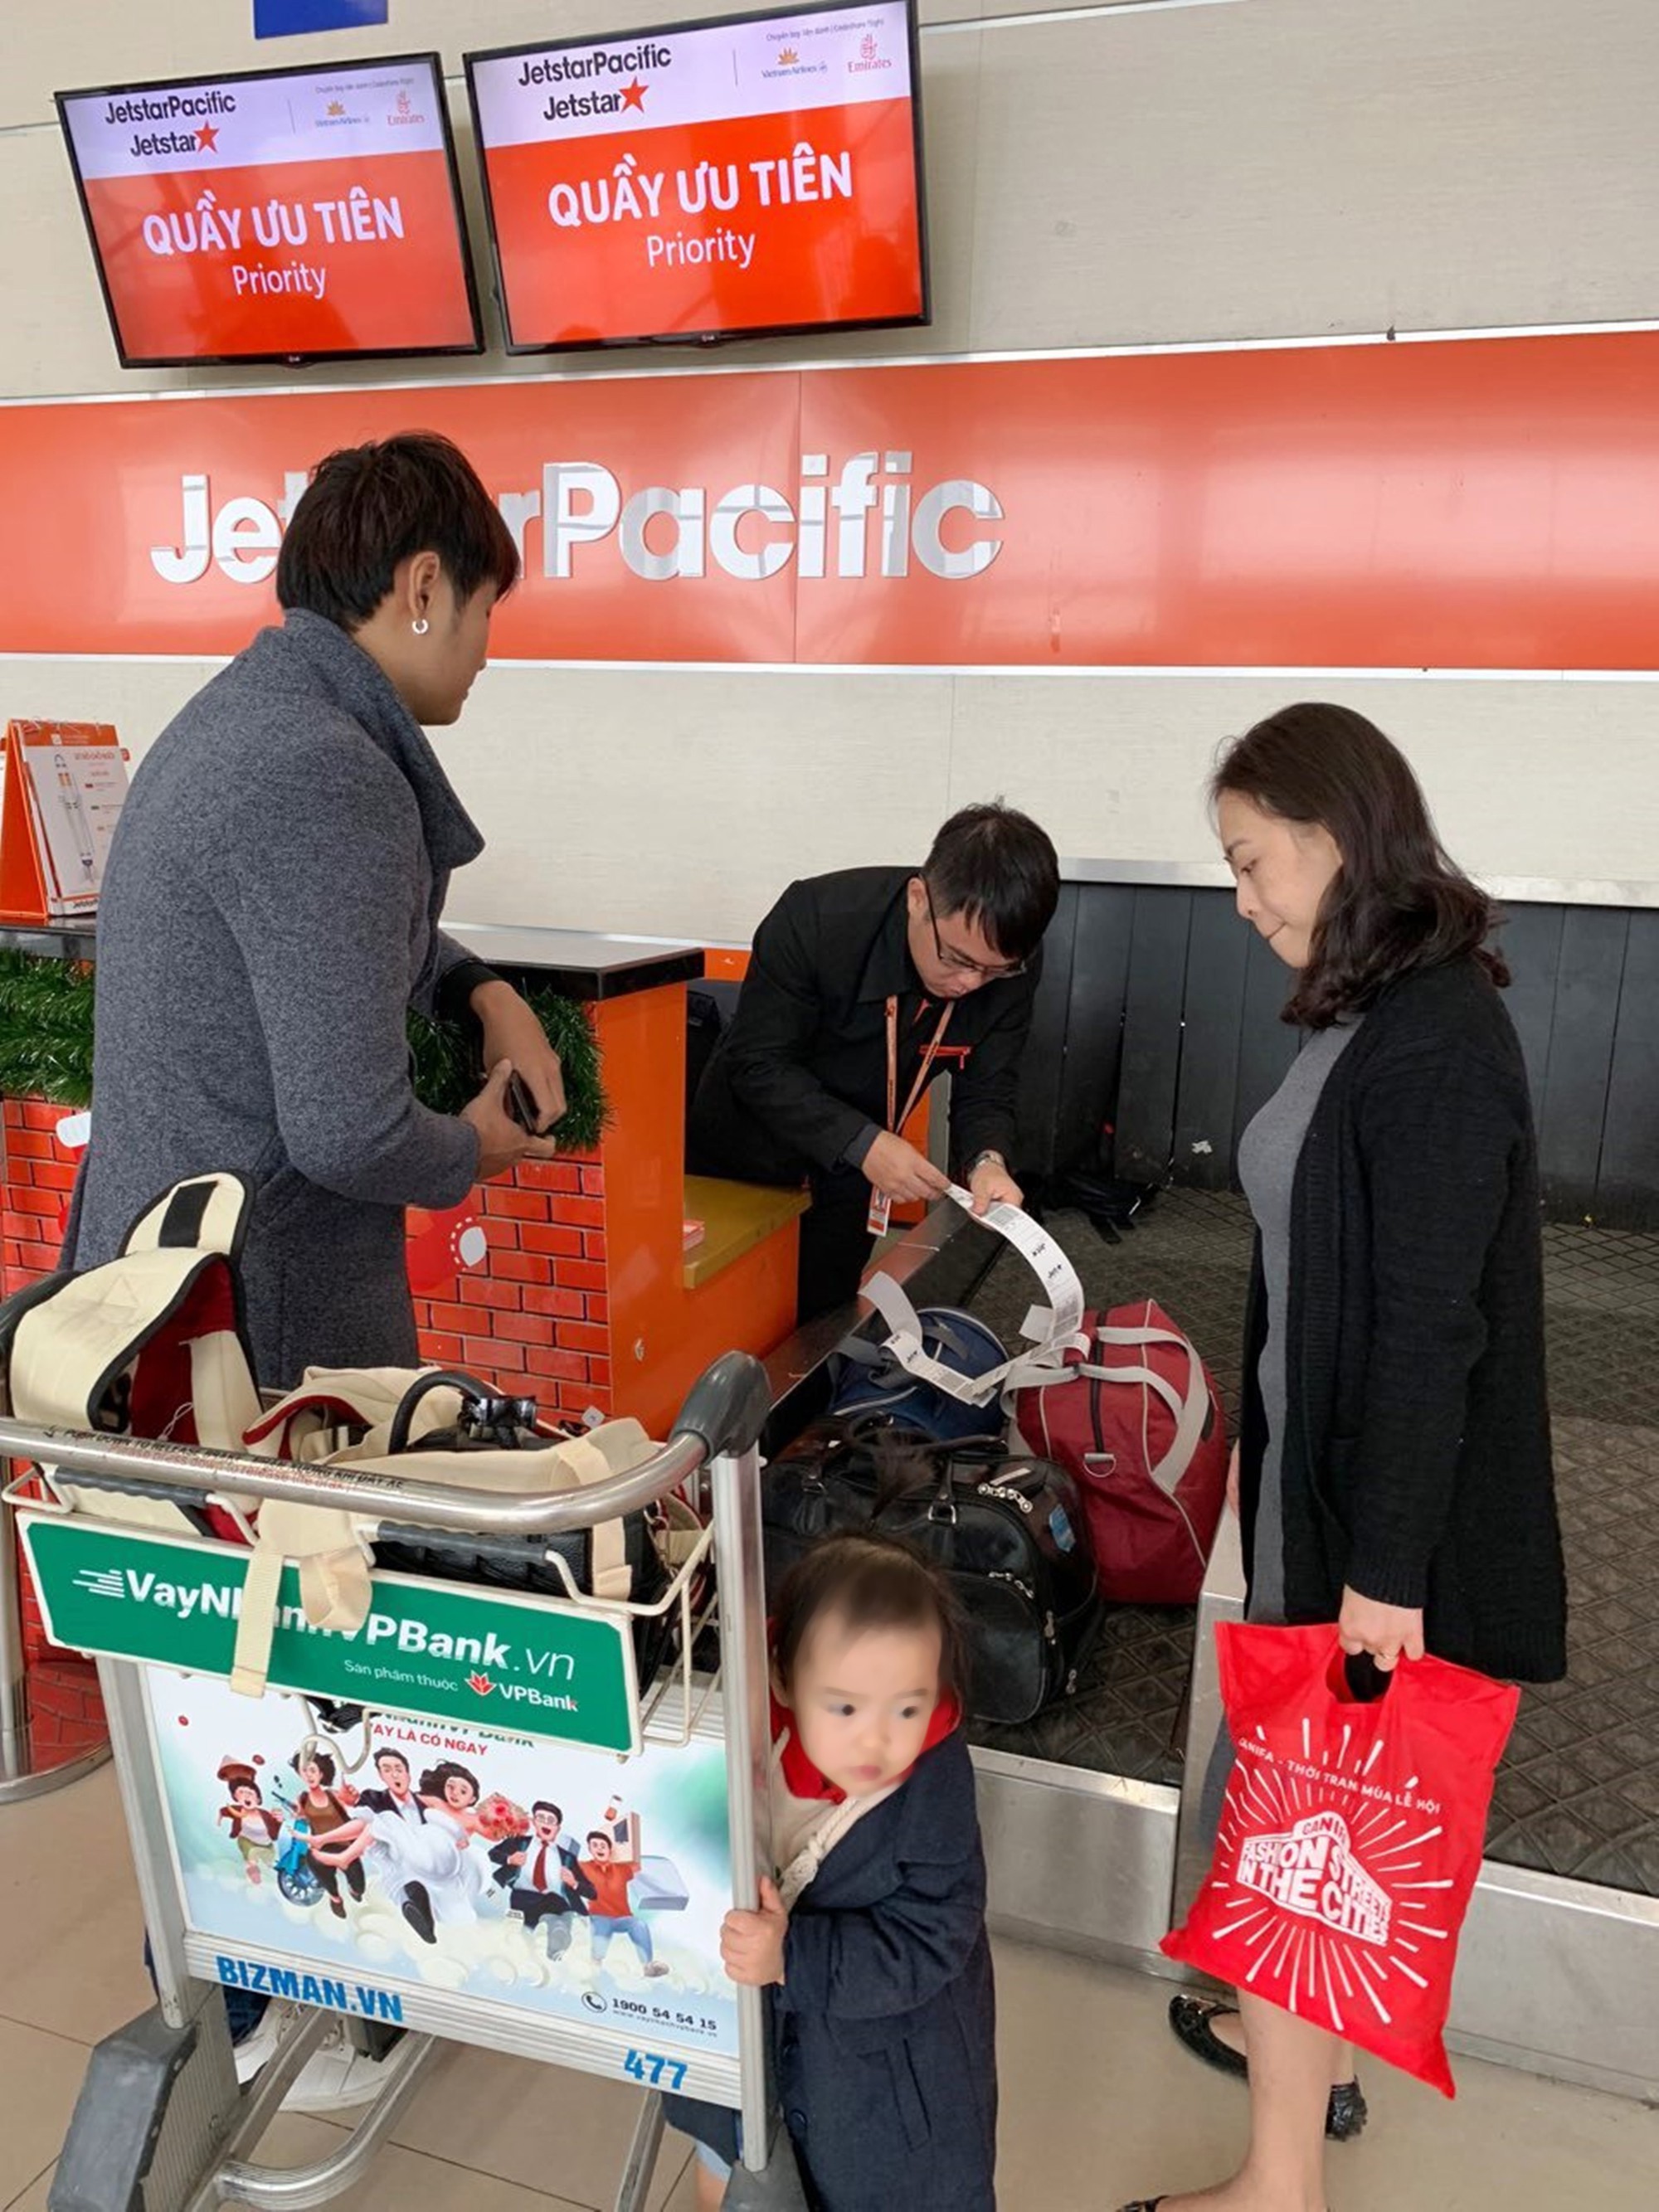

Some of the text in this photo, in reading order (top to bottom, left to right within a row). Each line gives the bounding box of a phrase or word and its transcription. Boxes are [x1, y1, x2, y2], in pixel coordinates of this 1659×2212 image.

[518, 43, 672, 86] JetstarPacific
[848, 58, 892, 73] Emirates
[105, 90, 236, 124] JetstarPacific
[543, 90, 621, 120] Jetstar
[130, 131, 197, 157] Jetstar
[548, 142, 852, 227] QUẦY ƯU TIÊN
[143, 186, 404, 255] QUẦY ƯU TIÊN
[647, 226, 755, 269] Priority
[232, 260, 325, 299] Priority
[150, 450, 1005, 584] JerPacific
[499, 1682, 579, 1713] VPBank
[445, 1736, 489, 1757] NGAY
[1259, 1862, 1325, 1913] THE
[216, 1954, 403, 2023] BIZMAN.VN
[612, 1998, 717, 2031] 1900 54 54 15
[624, 2048, 688, 2091] 477
